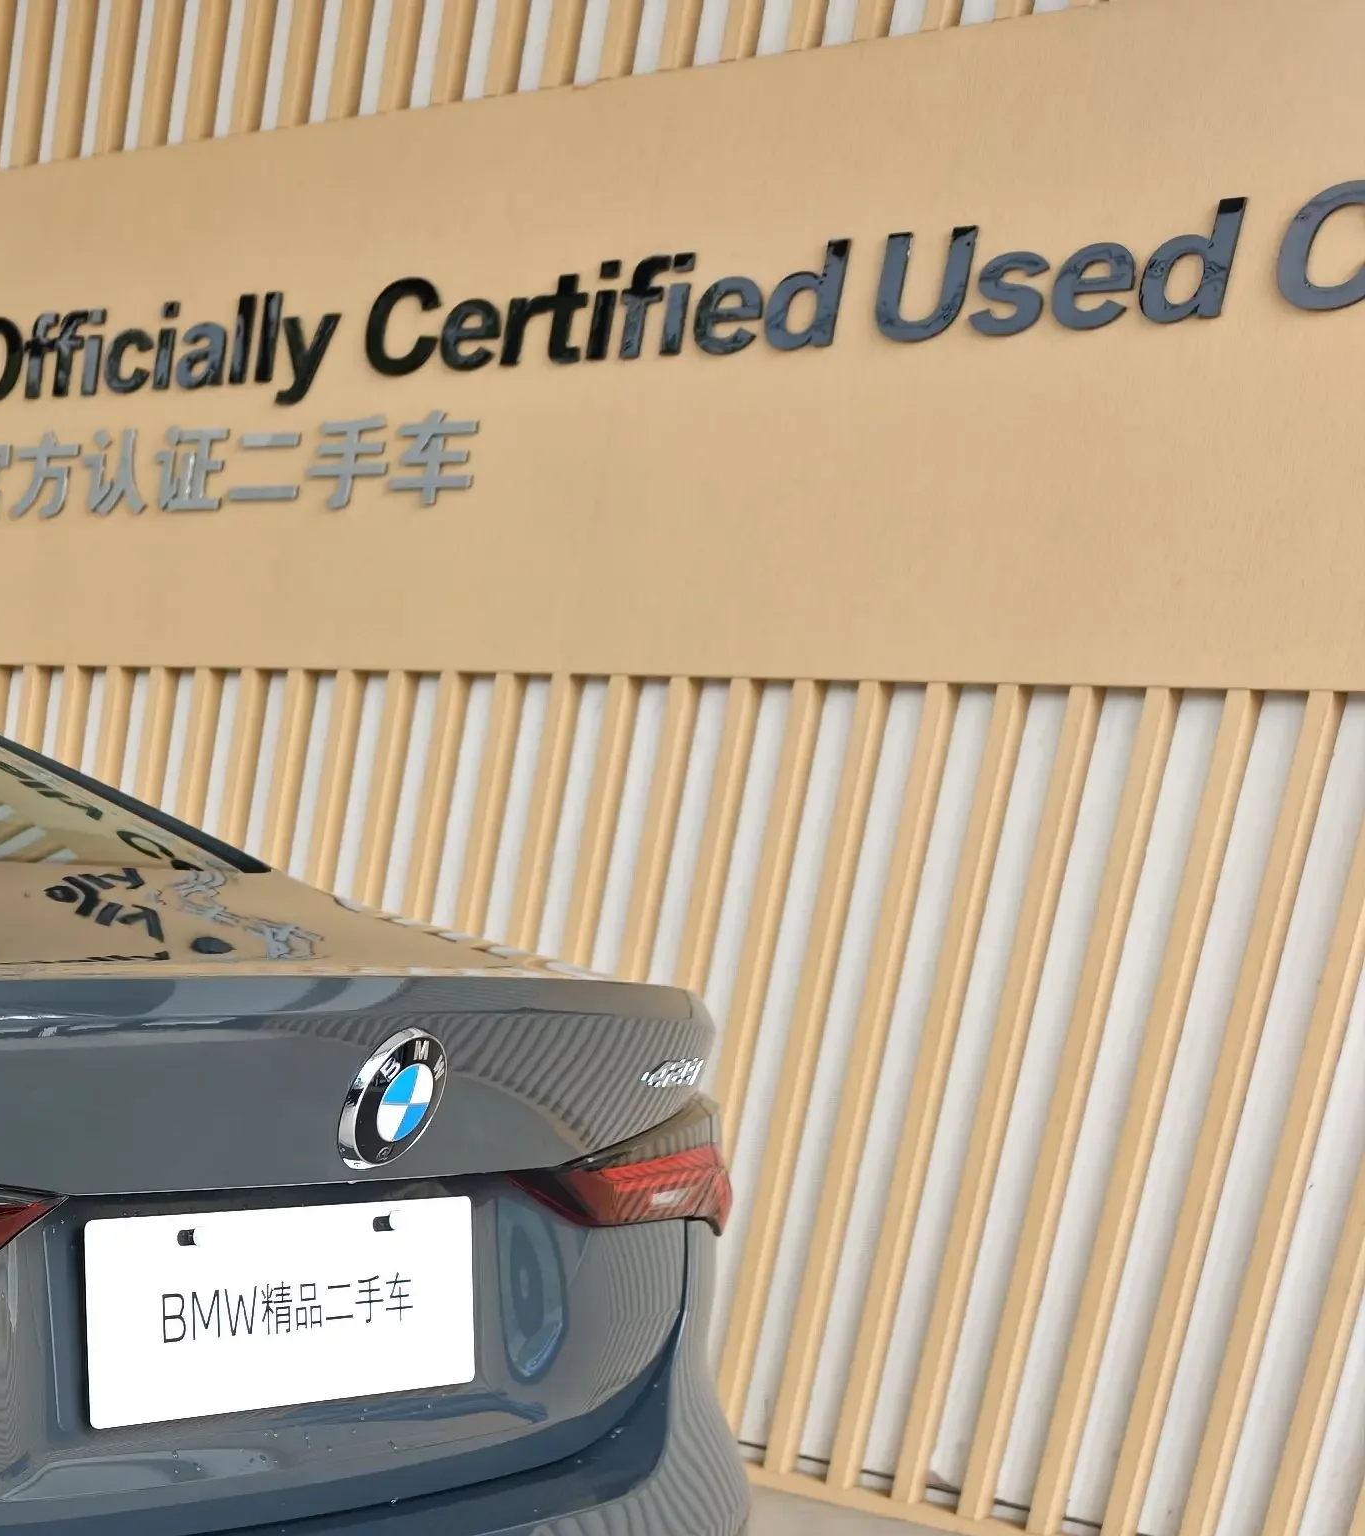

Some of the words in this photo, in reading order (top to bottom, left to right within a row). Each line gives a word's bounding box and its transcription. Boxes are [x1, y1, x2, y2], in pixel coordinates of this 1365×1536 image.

[364, 239, 850, 376] Certified
[874, 196, 1248, 343] Used
[379, 1039, 446, 1083] BMW
[161, 1271, 415, 1345] BMW精品二手车
